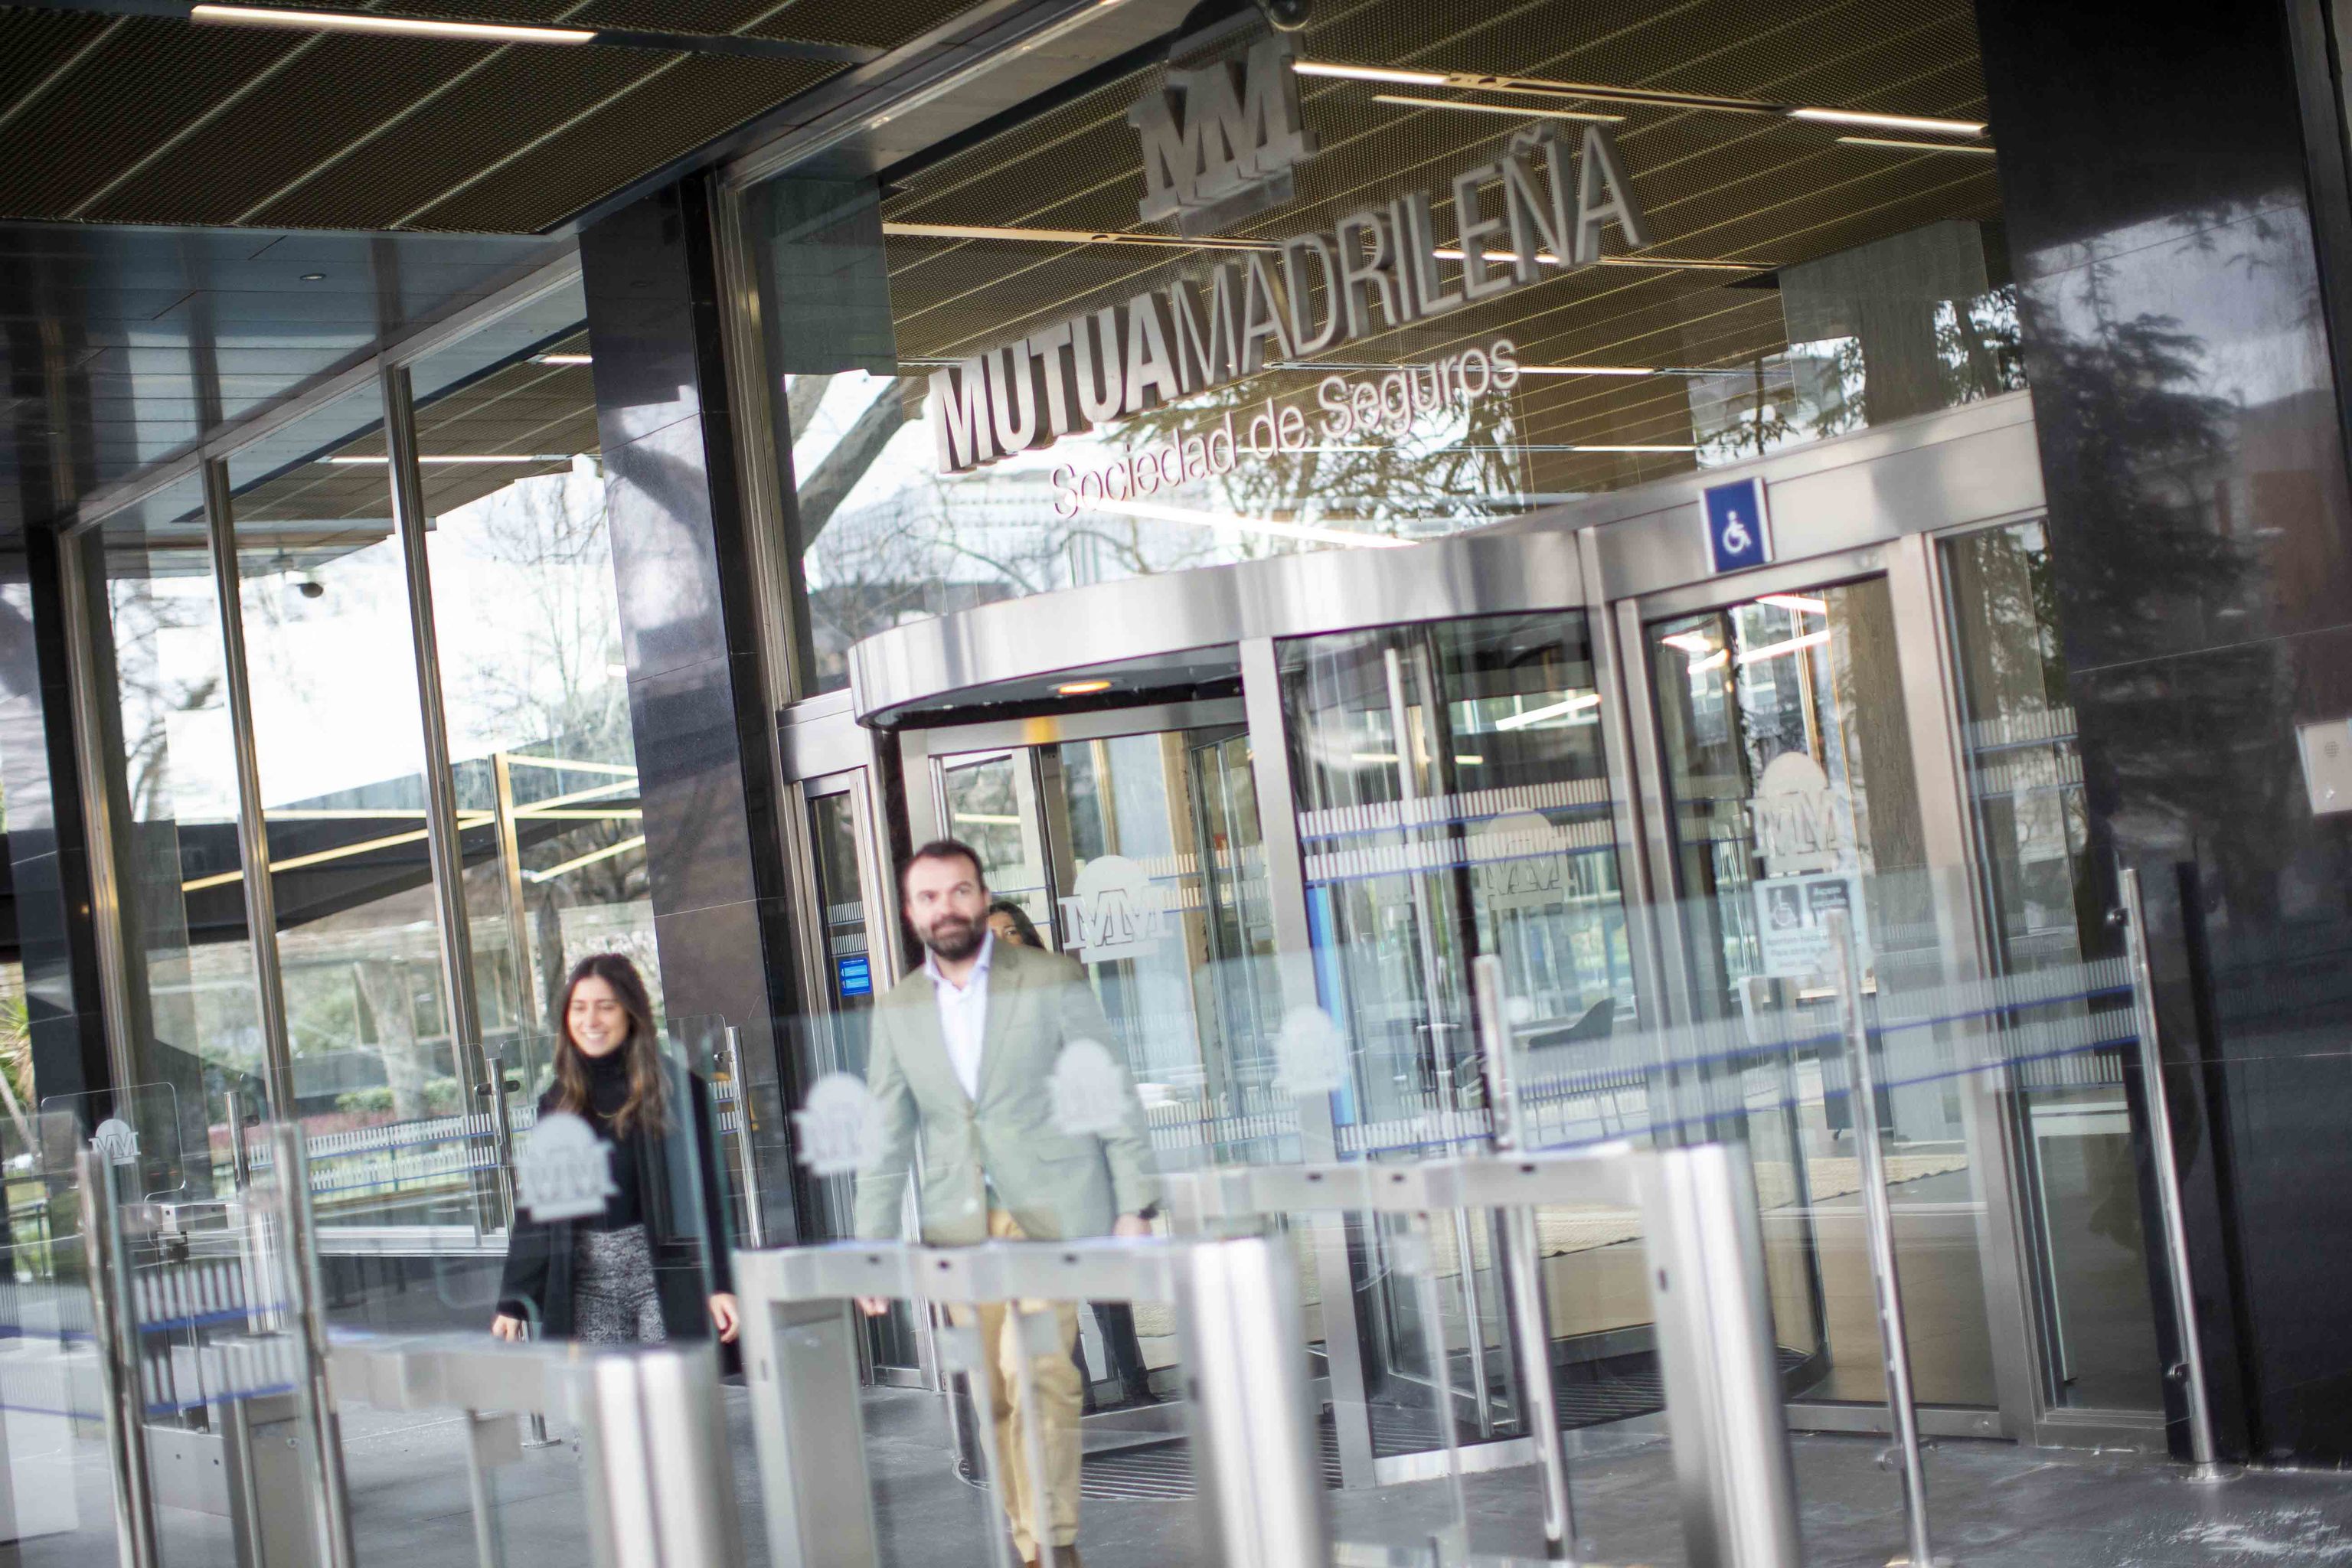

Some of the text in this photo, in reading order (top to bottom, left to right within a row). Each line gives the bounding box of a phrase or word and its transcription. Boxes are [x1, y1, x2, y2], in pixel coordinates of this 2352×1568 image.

[929, 122, 1651, 475] MUTUAMADRILEÑA
[1051, 338, 1519, 519] Sociedad de Seguros
